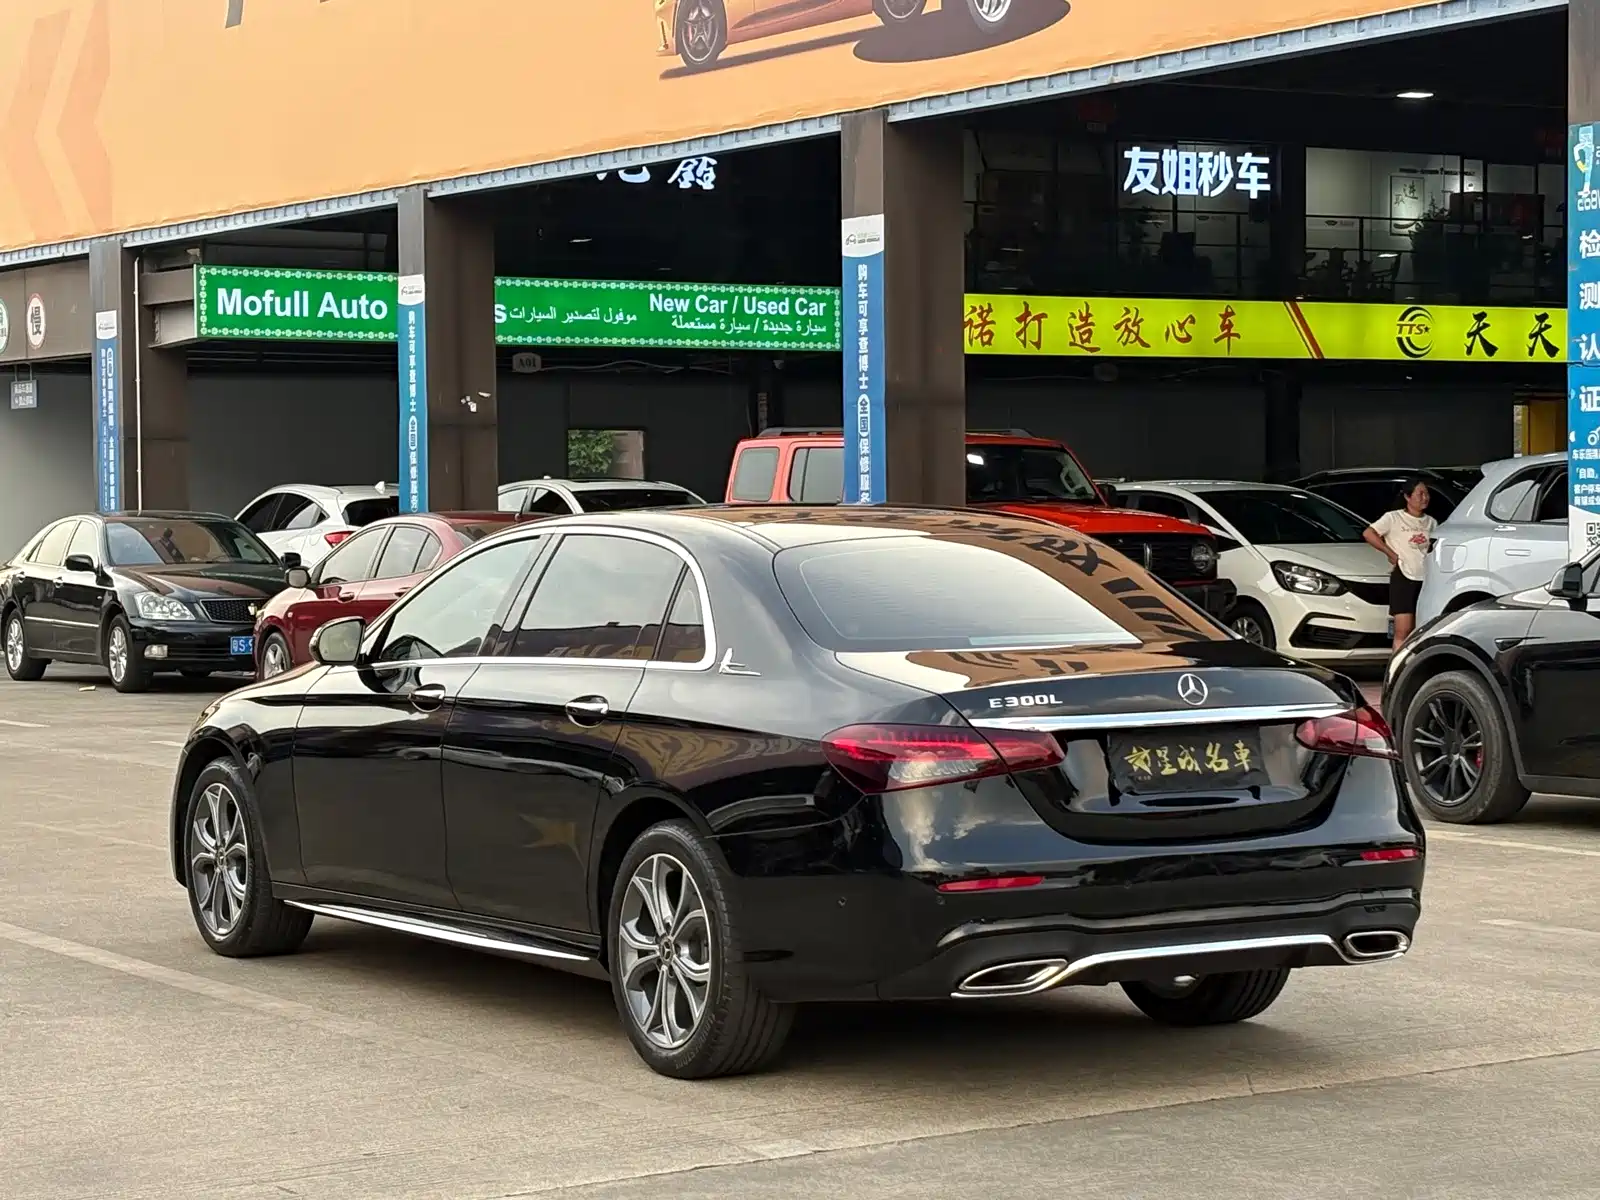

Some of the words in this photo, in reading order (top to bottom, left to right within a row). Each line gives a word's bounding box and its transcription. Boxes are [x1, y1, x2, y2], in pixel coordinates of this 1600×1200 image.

[1123, 146, 1271, 199] 友姐秒车
[217, 287, 310, 319] Mofull
[317, 292, 389, 320] Auto
[649, 293, 690, 313] New
[695, 295, 728, 315] Car
[732, 295, 739, 315] /
[743, 297, 790, 317] Used
[795, 299, 828, 318] Car
[964, 300, 1241, 357] 诺打造放心车
[1396, 323, 1426, 336] TTS
[1465, 310, 1560, 359] 天天
